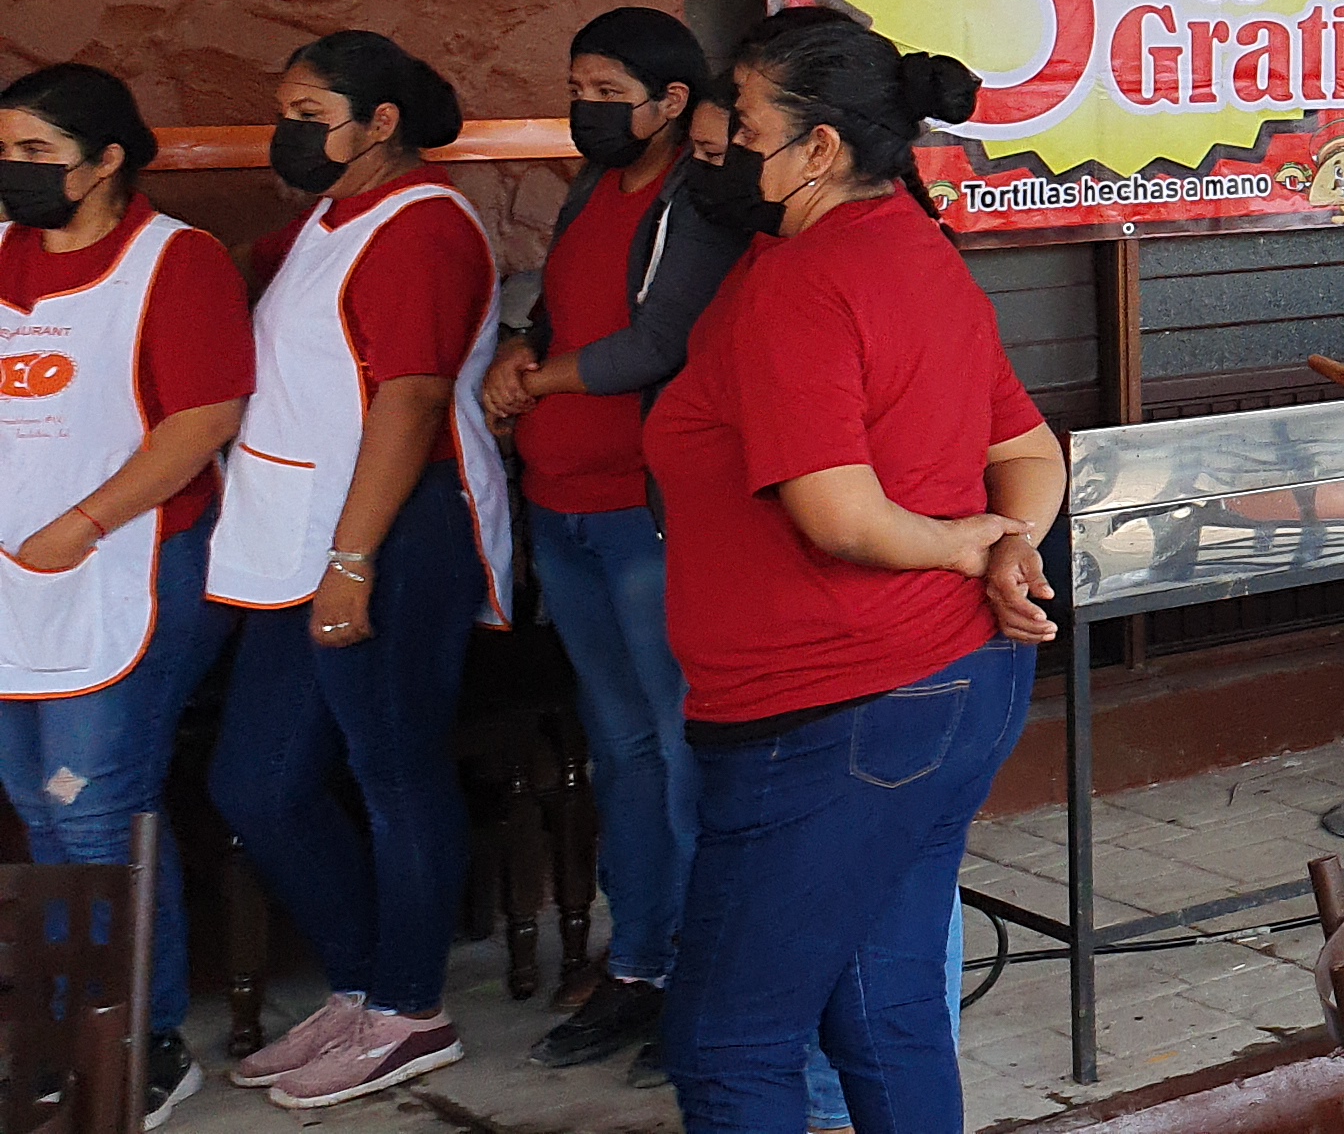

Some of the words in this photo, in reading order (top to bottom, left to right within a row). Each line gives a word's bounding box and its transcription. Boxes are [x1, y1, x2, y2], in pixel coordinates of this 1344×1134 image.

[962, 180, 1078, 213] Tortillas
[1082, 174, 1180, 206] hechas
[1183, 180, 1202, 201] a
[1203, 174, 1272, 200] mano
